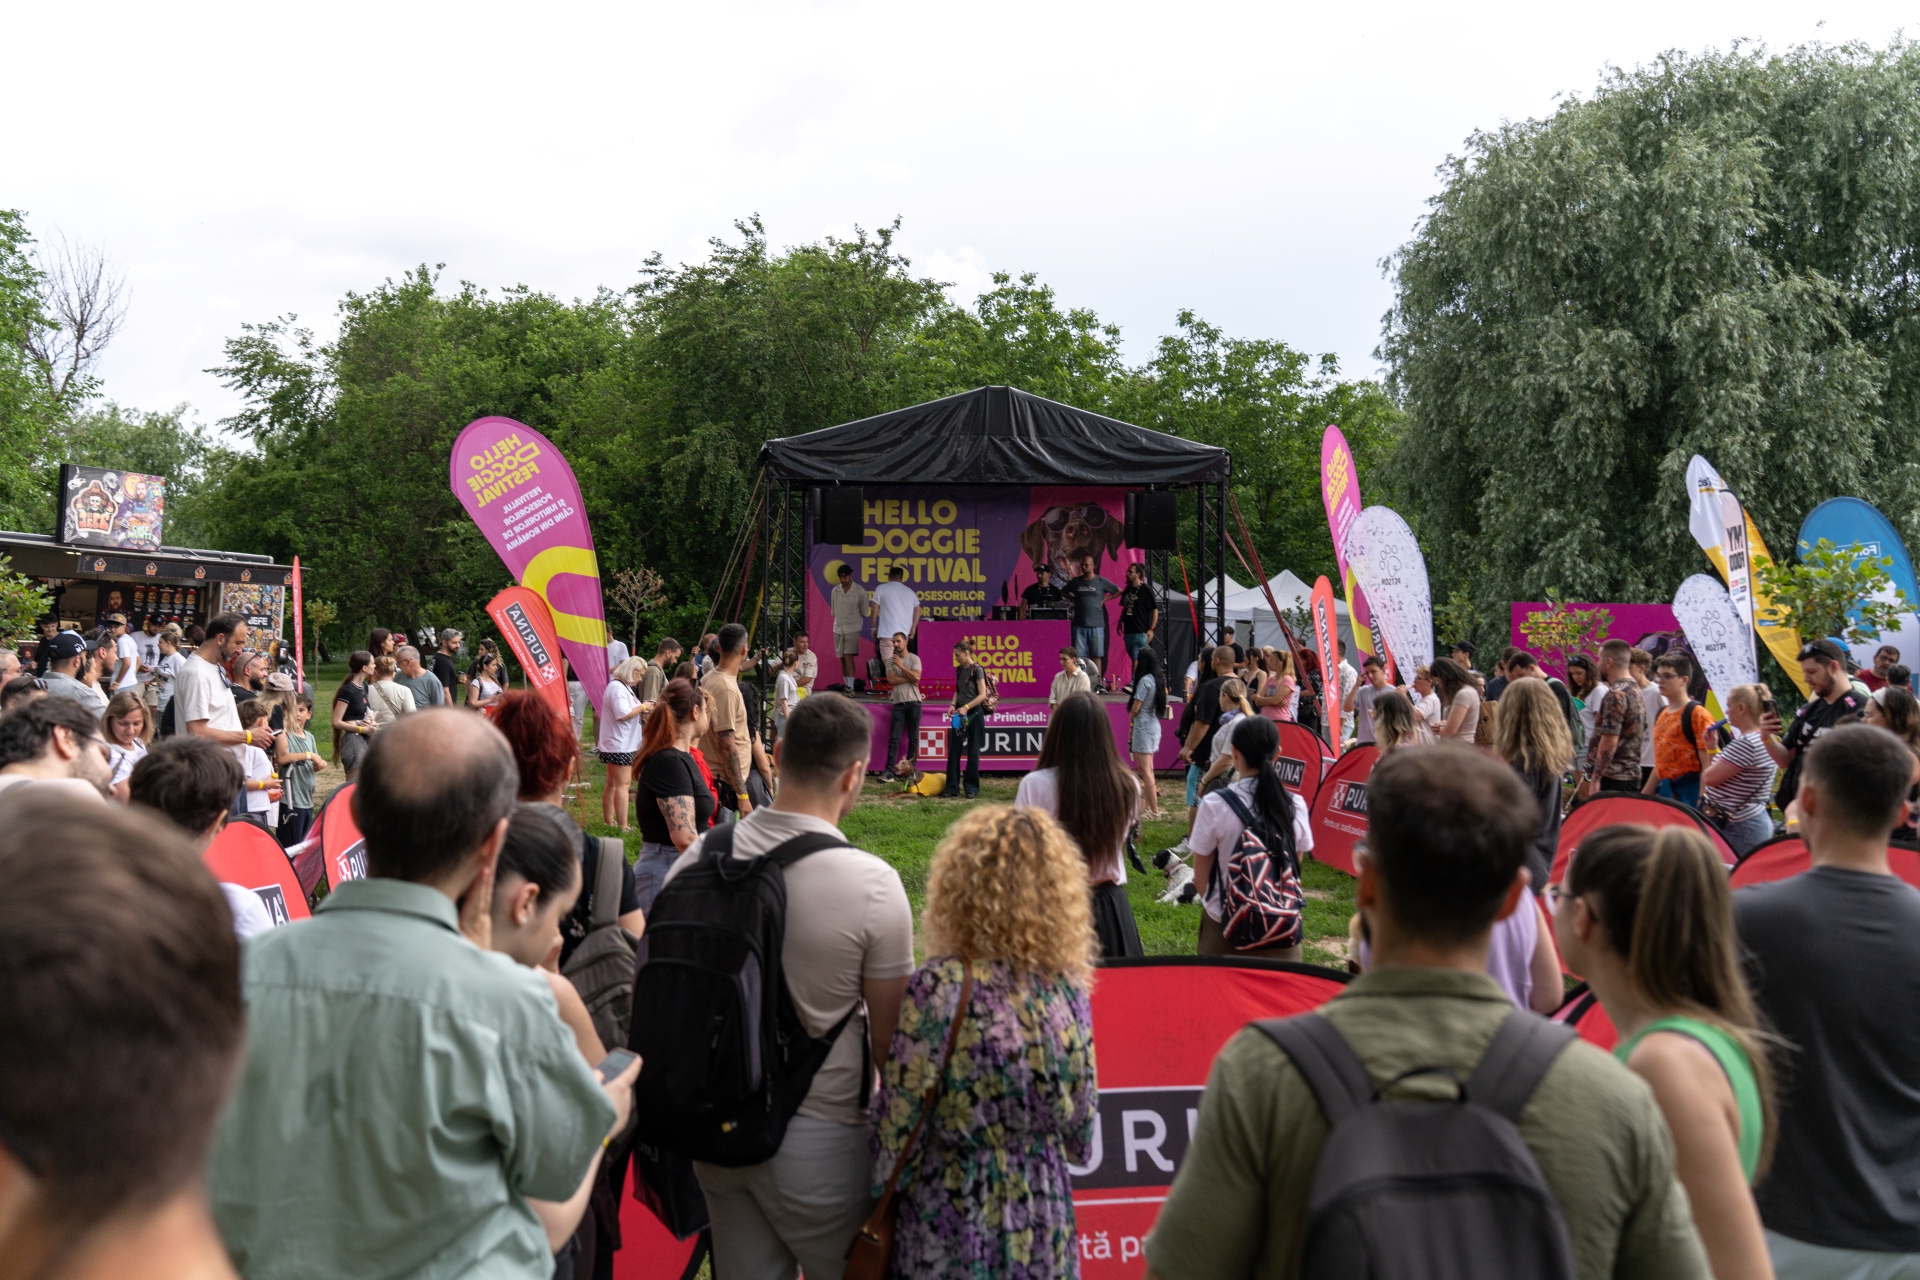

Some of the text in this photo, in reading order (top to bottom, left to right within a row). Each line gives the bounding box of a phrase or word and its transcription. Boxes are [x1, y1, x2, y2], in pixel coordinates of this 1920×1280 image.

[864, 500, 958, 524] HELLO
[842, 528, 980, 554] DOGGIE
[861, 558, 987, 583] FESTIVAL
[934, 606, 949, 616] DE
[994, 711, 1046, 724] Principal:
